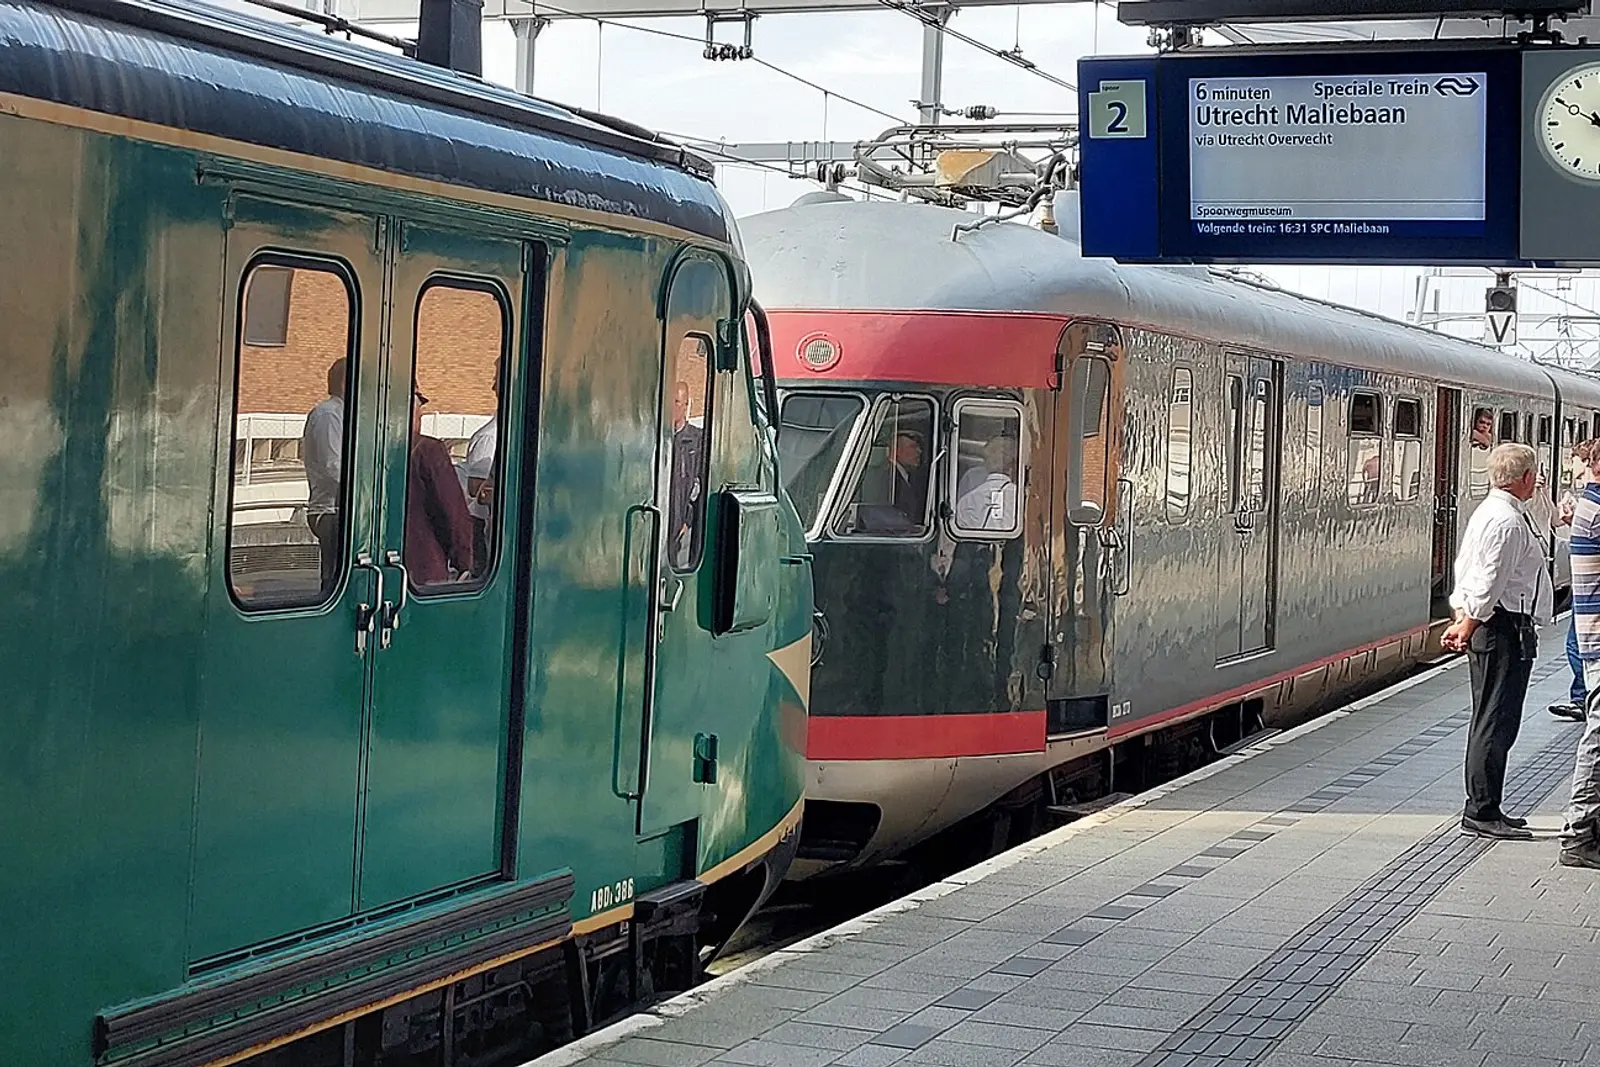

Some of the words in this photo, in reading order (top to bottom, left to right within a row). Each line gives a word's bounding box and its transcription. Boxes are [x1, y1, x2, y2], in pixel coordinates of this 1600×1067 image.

[1196, 82, 1207, 100] 6
[1212, 86, 1270, 100] minuten
[1314, 80, 1383, 99] Speciale
[1388, 79, 1429, 95] Trein
[1107, 102, 1128, 133] 2
[1197, 103, 1279, 126] Utrecht
[1286, 102, 1405, 125] Maliebaan
[1195, 133, 1214, 146] via
[1218, 133, 1264, 146] Utrecht
[1268, 132, 1333, 146] Overvecht
[1197, 205, 1293, 218] Spoorwegmuseum
[1197, 222, 1246, 236] Volgende
[1248, 222, 1276, 234] trein:
[1279, 222, 1307, 234] 16:31
[1310, 222, 1331, 234] SPC
[1333, 222, 1390, 234] Maliebaan
[1488, 314, 1513, 343] V
[614, 877, 634, 903] 386
